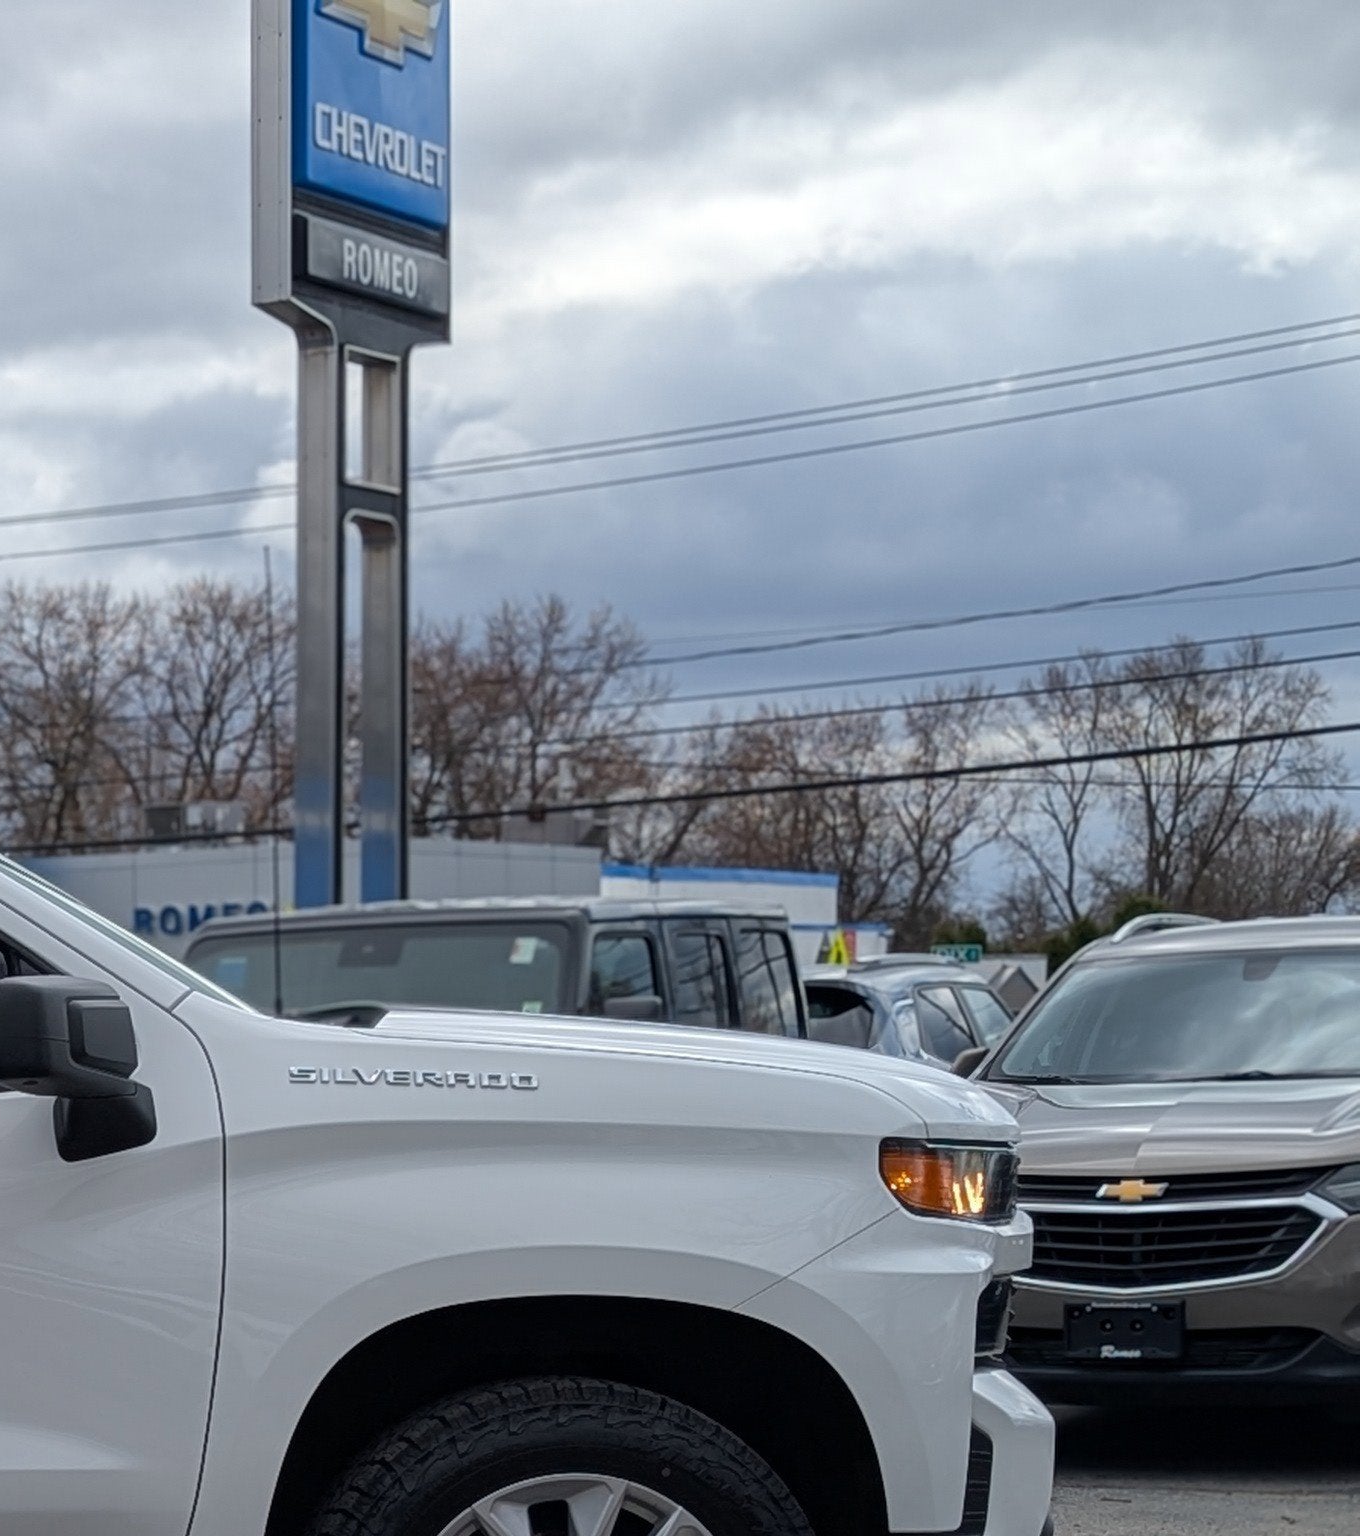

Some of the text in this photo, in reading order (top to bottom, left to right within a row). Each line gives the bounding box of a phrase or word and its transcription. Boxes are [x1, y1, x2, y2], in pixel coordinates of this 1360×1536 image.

[315, 102, 447, 188] CHEVROLET
[343, 239, 418, 298] ROMEO
[288, 1066, 539, 1090] SILVERADO
